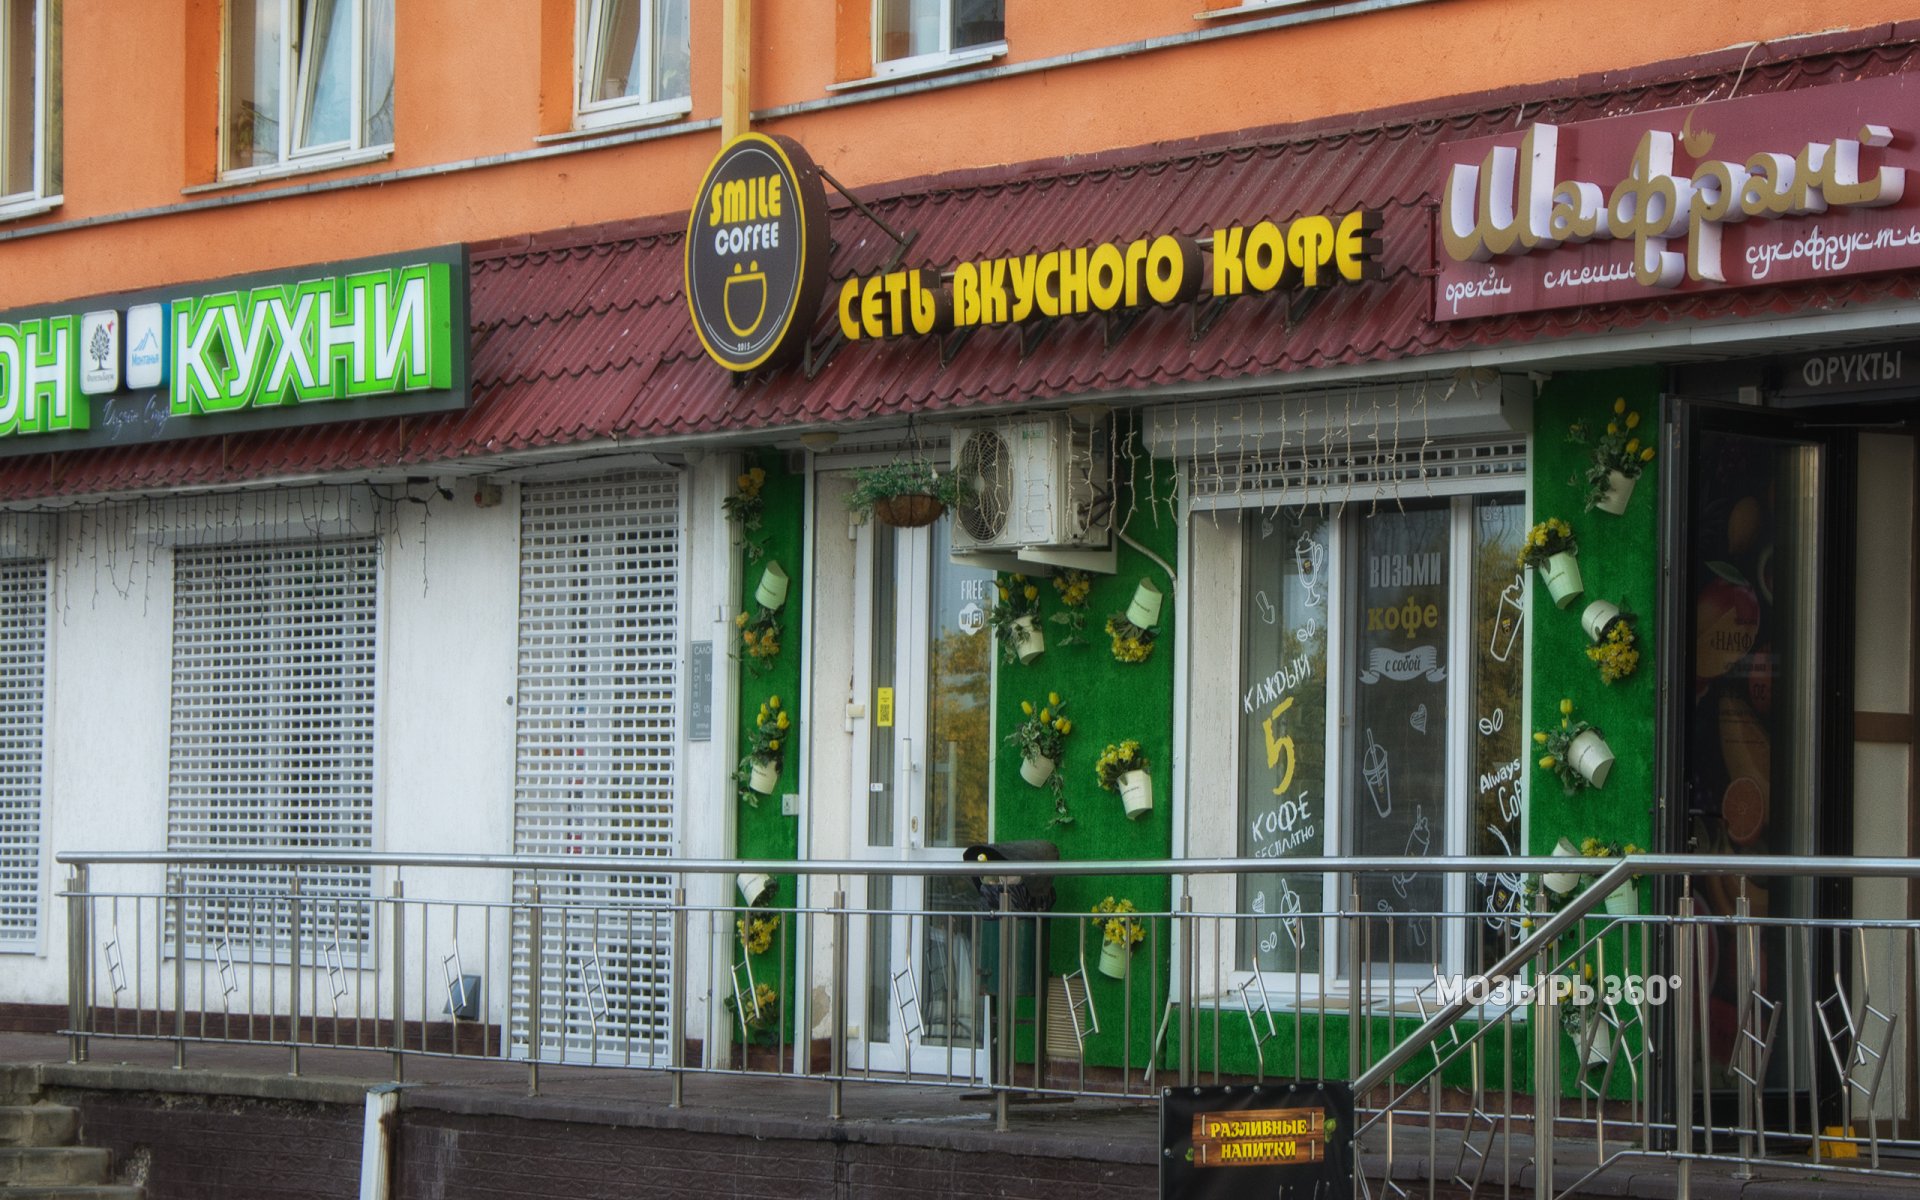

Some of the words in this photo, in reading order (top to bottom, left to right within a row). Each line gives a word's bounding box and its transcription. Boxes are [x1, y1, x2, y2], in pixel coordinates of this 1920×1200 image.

[710, 174, 781, 227] SMILE
[1442, 122, 1905, 288] Шафран
[715, 222, 779, 255] COFFEE
[839, 269, 936, 340] СЕТЬ
[953, 235, 1184, 327] ВКУСНОГО
[1213, 211, 1364, 297] КОФЕ
[171, 263, 440, 416] КУХНИ
[1803, 351, 1901, 386] ФРУКТЫ
[961, 580, 983, 600] FREE
[1369, 552, 1441, 588] ВОЗЬМИ
[1367, 597, 1439, 639] кофе
[1243, 654, 1311, 714] КАЖДЫЙ
[1384, 660, 1391, 672] с
[1392, 654, 1421, 672] собой
[1262, 696, 1296, 796] 5
[1480, 758, 1521, 794] Always
[1252, 790, 1312, 842] КОФЕ
[1498, 777, 1522, 822] Cof
[1210, 1119, 1307, 1138] РАЗЛИВНЫЕ
[1221, 1141, 1296, 1159] НАПИТКИ
